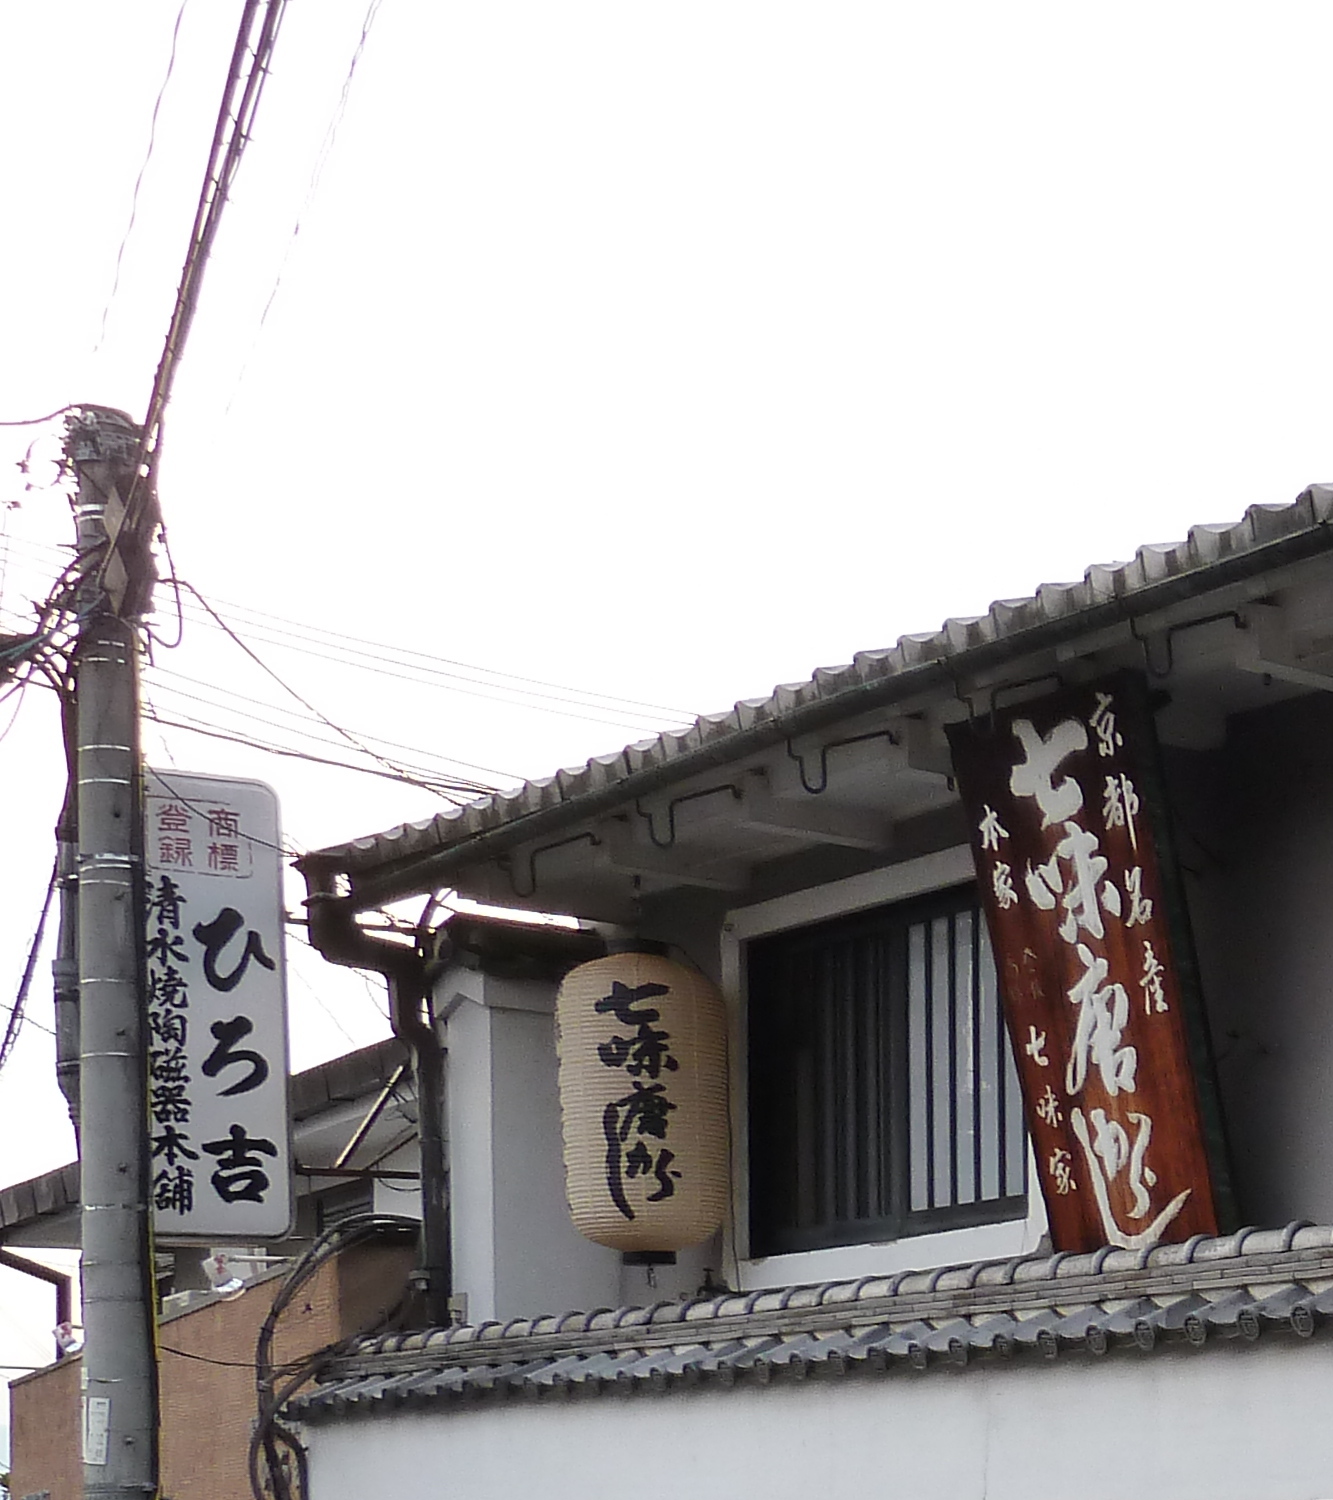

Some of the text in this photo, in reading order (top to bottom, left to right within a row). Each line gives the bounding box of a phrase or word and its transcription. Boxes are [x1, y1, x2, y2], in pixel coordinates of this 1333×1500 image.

[154, 803, 194, 867] 登録
[206, 807, 241, 873] 商標
[192, 906, 277, 1205] ひろ吉
